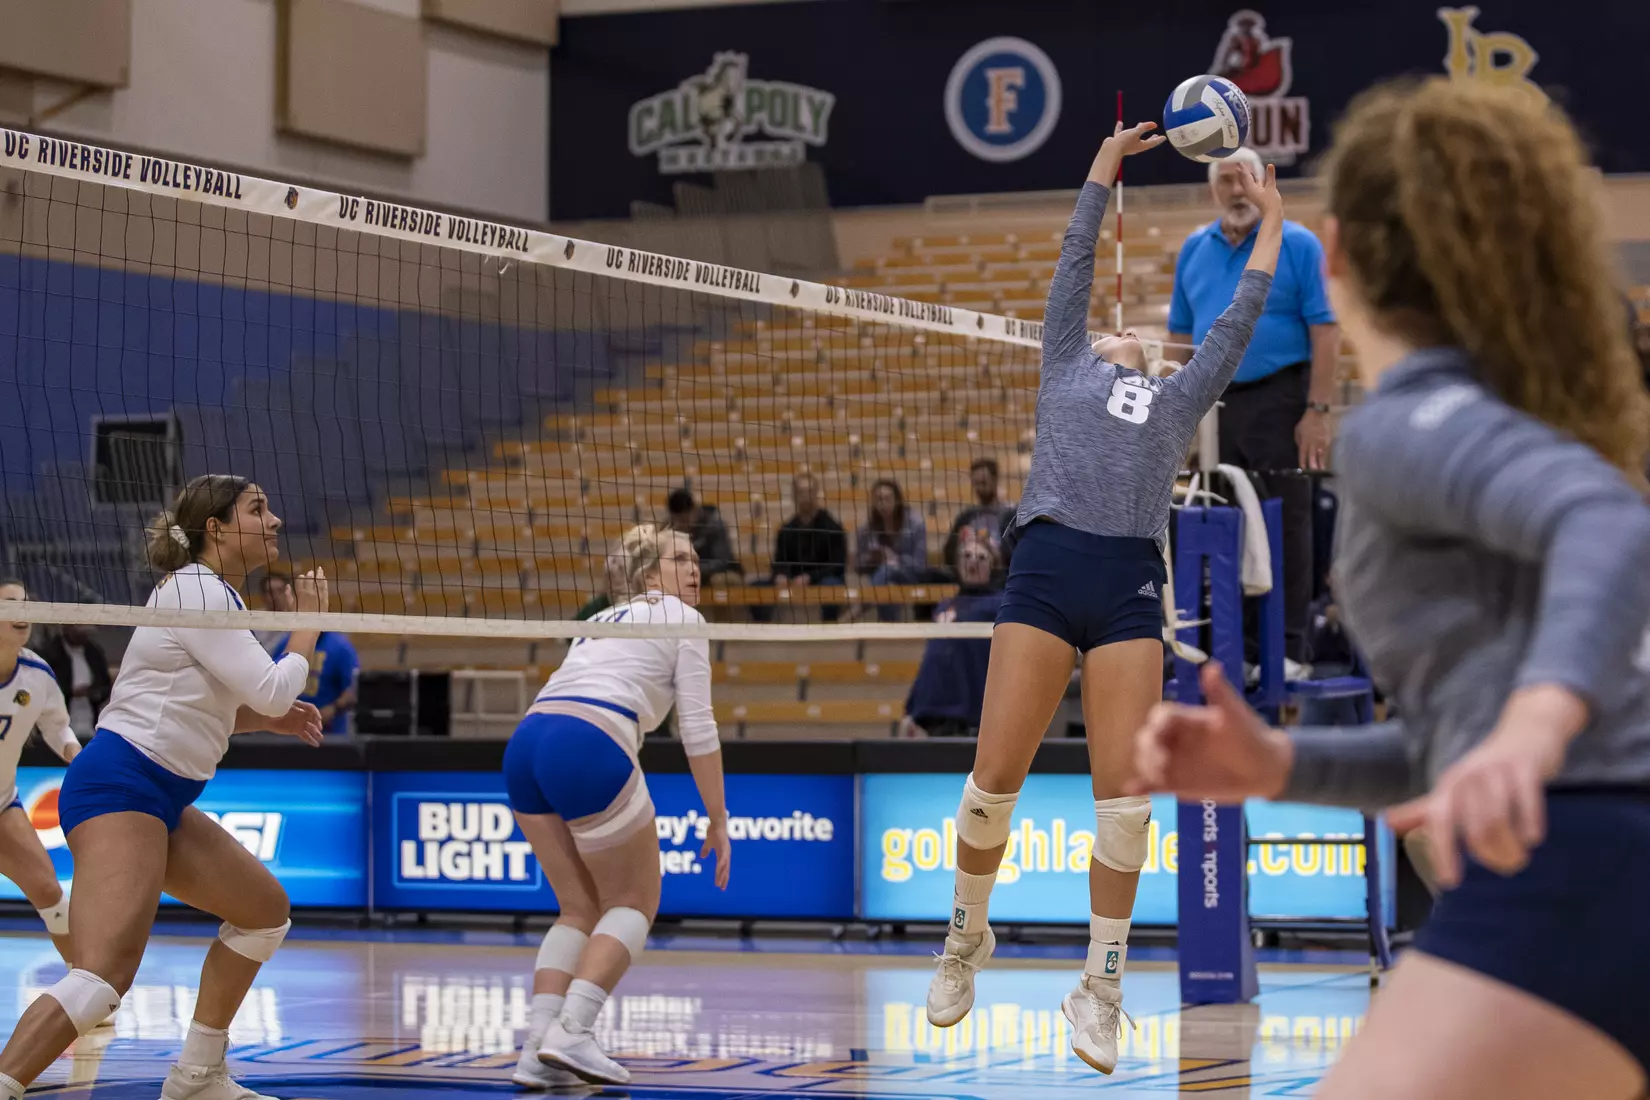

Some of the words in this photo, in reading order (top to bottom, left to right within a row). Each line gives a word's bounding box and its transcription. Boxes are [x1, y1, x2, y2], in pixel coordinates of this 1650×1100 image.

[632, 88, 699, 150] CAL
[742, 82, 830, 140] POLY
[984, 66, 1027, 135] F
[1251, 102, 1303, 149] UN
[4, 130, 30, 159] UC
[37, 137, 134, 180] RIVERSIDE
[140, 157, 242, 200] VOLLEYBALL
[339, 195, 360, 221] UC
[364, 201, 443, 237] RIVERSIDE
[448, 216, 529, 252] VOLLEYBALL
[606, 247, 623, 269] UC
[627, 251, 691, 282] RIVERSIDE
[694, 262, 761, 294] VOLLEYBALL
[825, 286, 840, 304] UC
[845, 288, 895, 315] RIVERSIDE
[898, 297, 954, 325] VOLLEYBALL
[1020, 320, 1043, 341] RIVER
[1106, 377, 1154, 425] 8
[203, 811, 283, 862] SI
[418, 802, 514, 841] BUD
[655, 809, 711, 845] ay's
[725, 810, 834, 842] avorite
[1201, 797, 1219, 842] ports
[401, 839, 533, 881] LIGHT
[660, 850, 702, 877] er.
